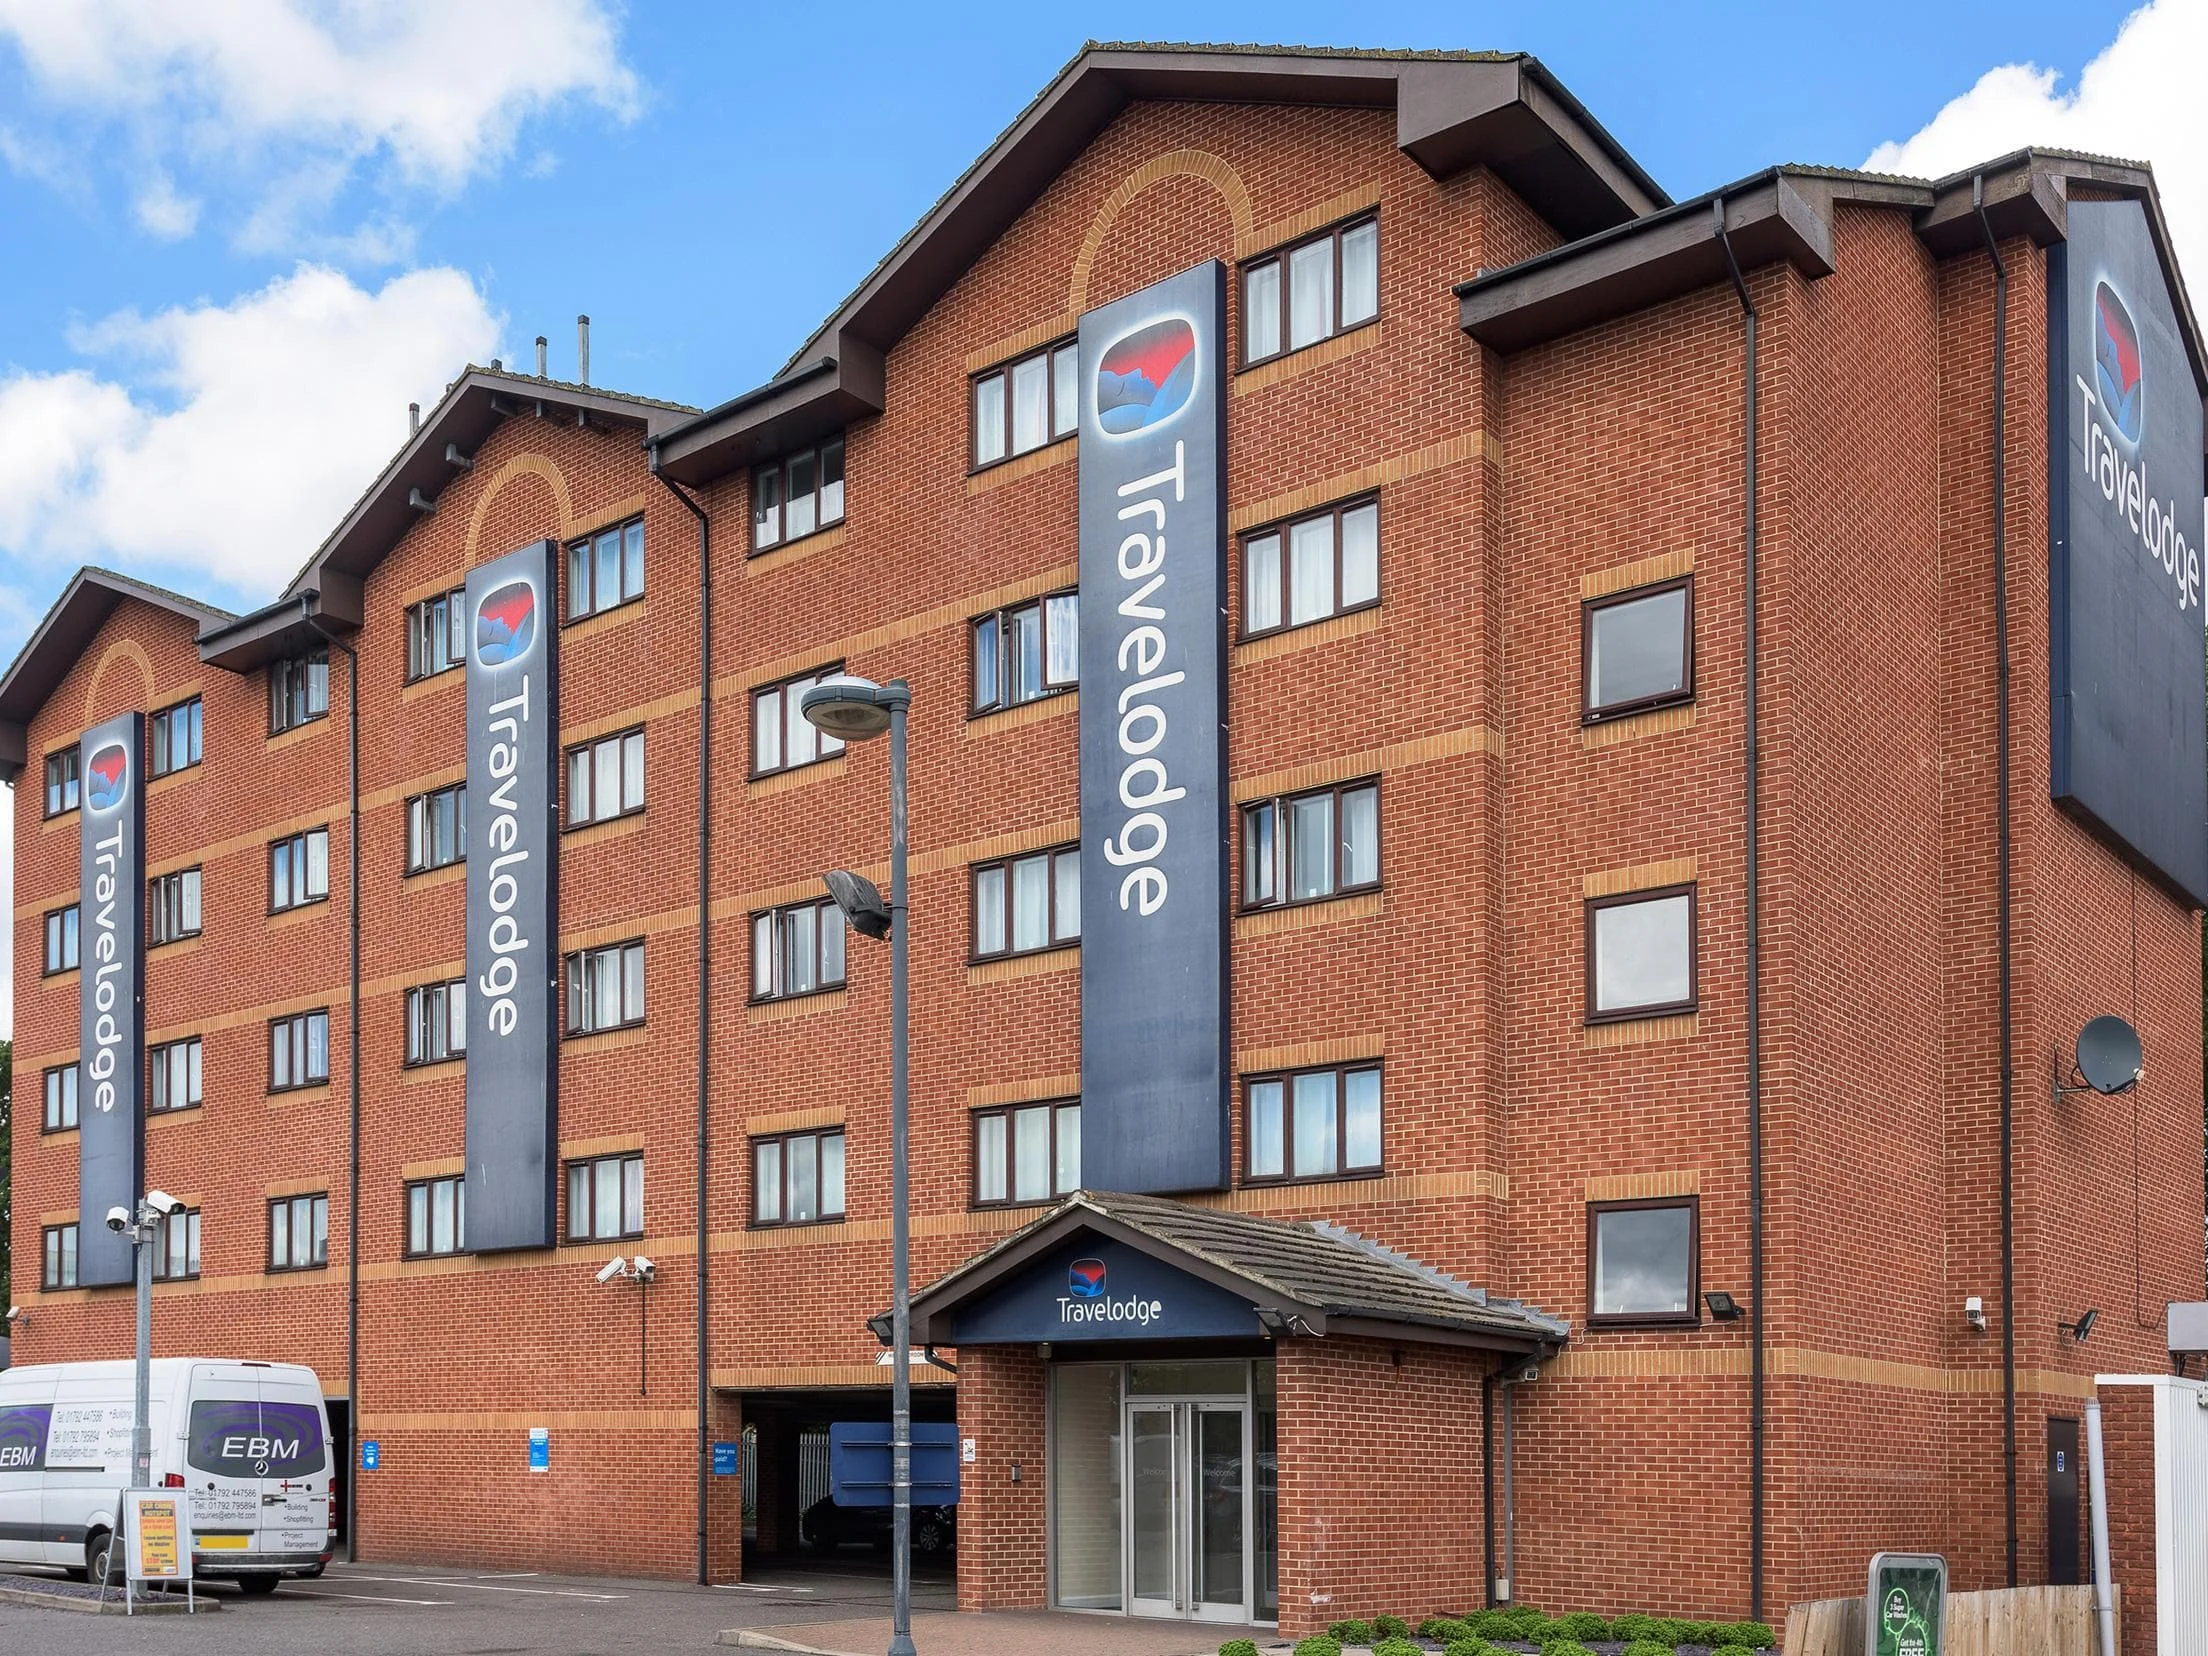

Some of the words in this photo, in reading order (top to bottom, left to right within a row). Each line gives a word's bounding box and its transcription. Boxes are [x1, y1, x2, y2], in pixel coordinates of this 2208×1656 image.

[2076, 374, 2200, 611] Travelodge
[1104, 439, 1187, 916] Travelodge
[480, 674, 529, 1037] Travelodge
[89, 819, 122, 1112] Travelodge
[1056, 1294, 1162, 1326] Travelodge
[0, 1446, 37, 1466] EBM
[222, 1437, 299, 1459] EBM
[208, 1489, 230, 1497] 01792
[232, 1489, 256, 1497] 447586
[208, 1501, 230, 1510] 01792
[232, 1502, 256, 1510] 795894
[284, 1541, 319, 1549] Management
[1900, 1648, 1925, 1656] FREE
[1901, 1638, 1909, 1647] Get
